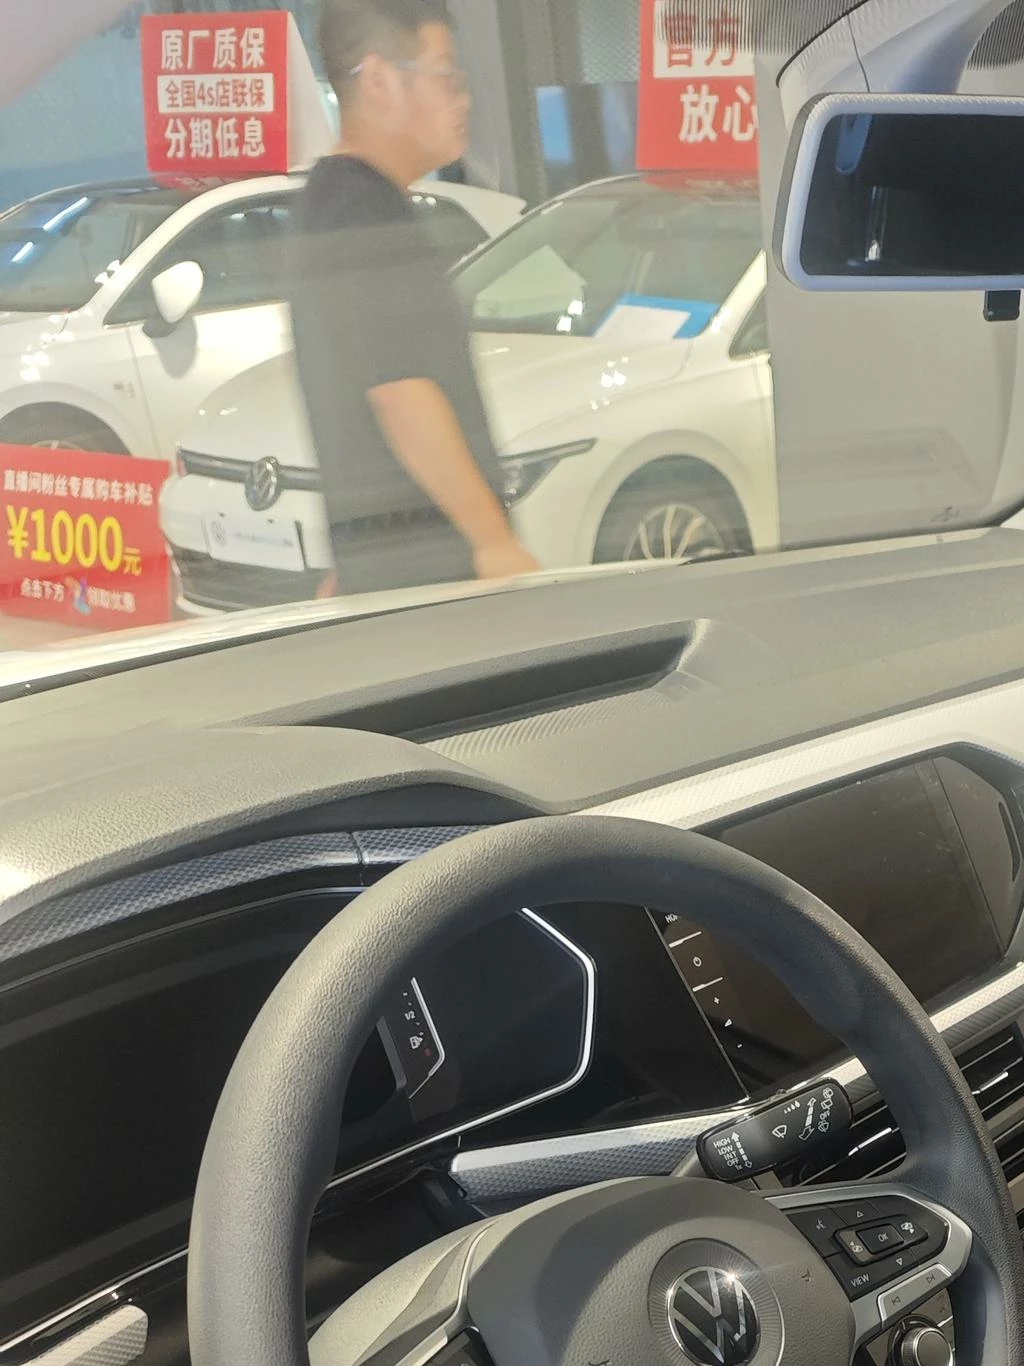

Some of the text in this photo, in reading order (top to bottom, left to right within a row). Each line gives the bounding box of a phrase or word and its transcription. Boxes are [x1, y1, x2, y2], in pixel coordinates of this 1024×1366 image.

[161, 27, 265, 70] 原厂质保
[165, 78, 265, 108] 全国4s店联保
[679, 84, 758, 142] 放心
[165, 117, 265, 158] 分期低息
[713, 1137, 731, 1148] HIGH
[717, 1145, 733, 1155] LOW
[723, 1151, 737, 1161] INT
[878, 1233, 889, 1242] OK
[851, 1273, 870, 1288] VIEW
